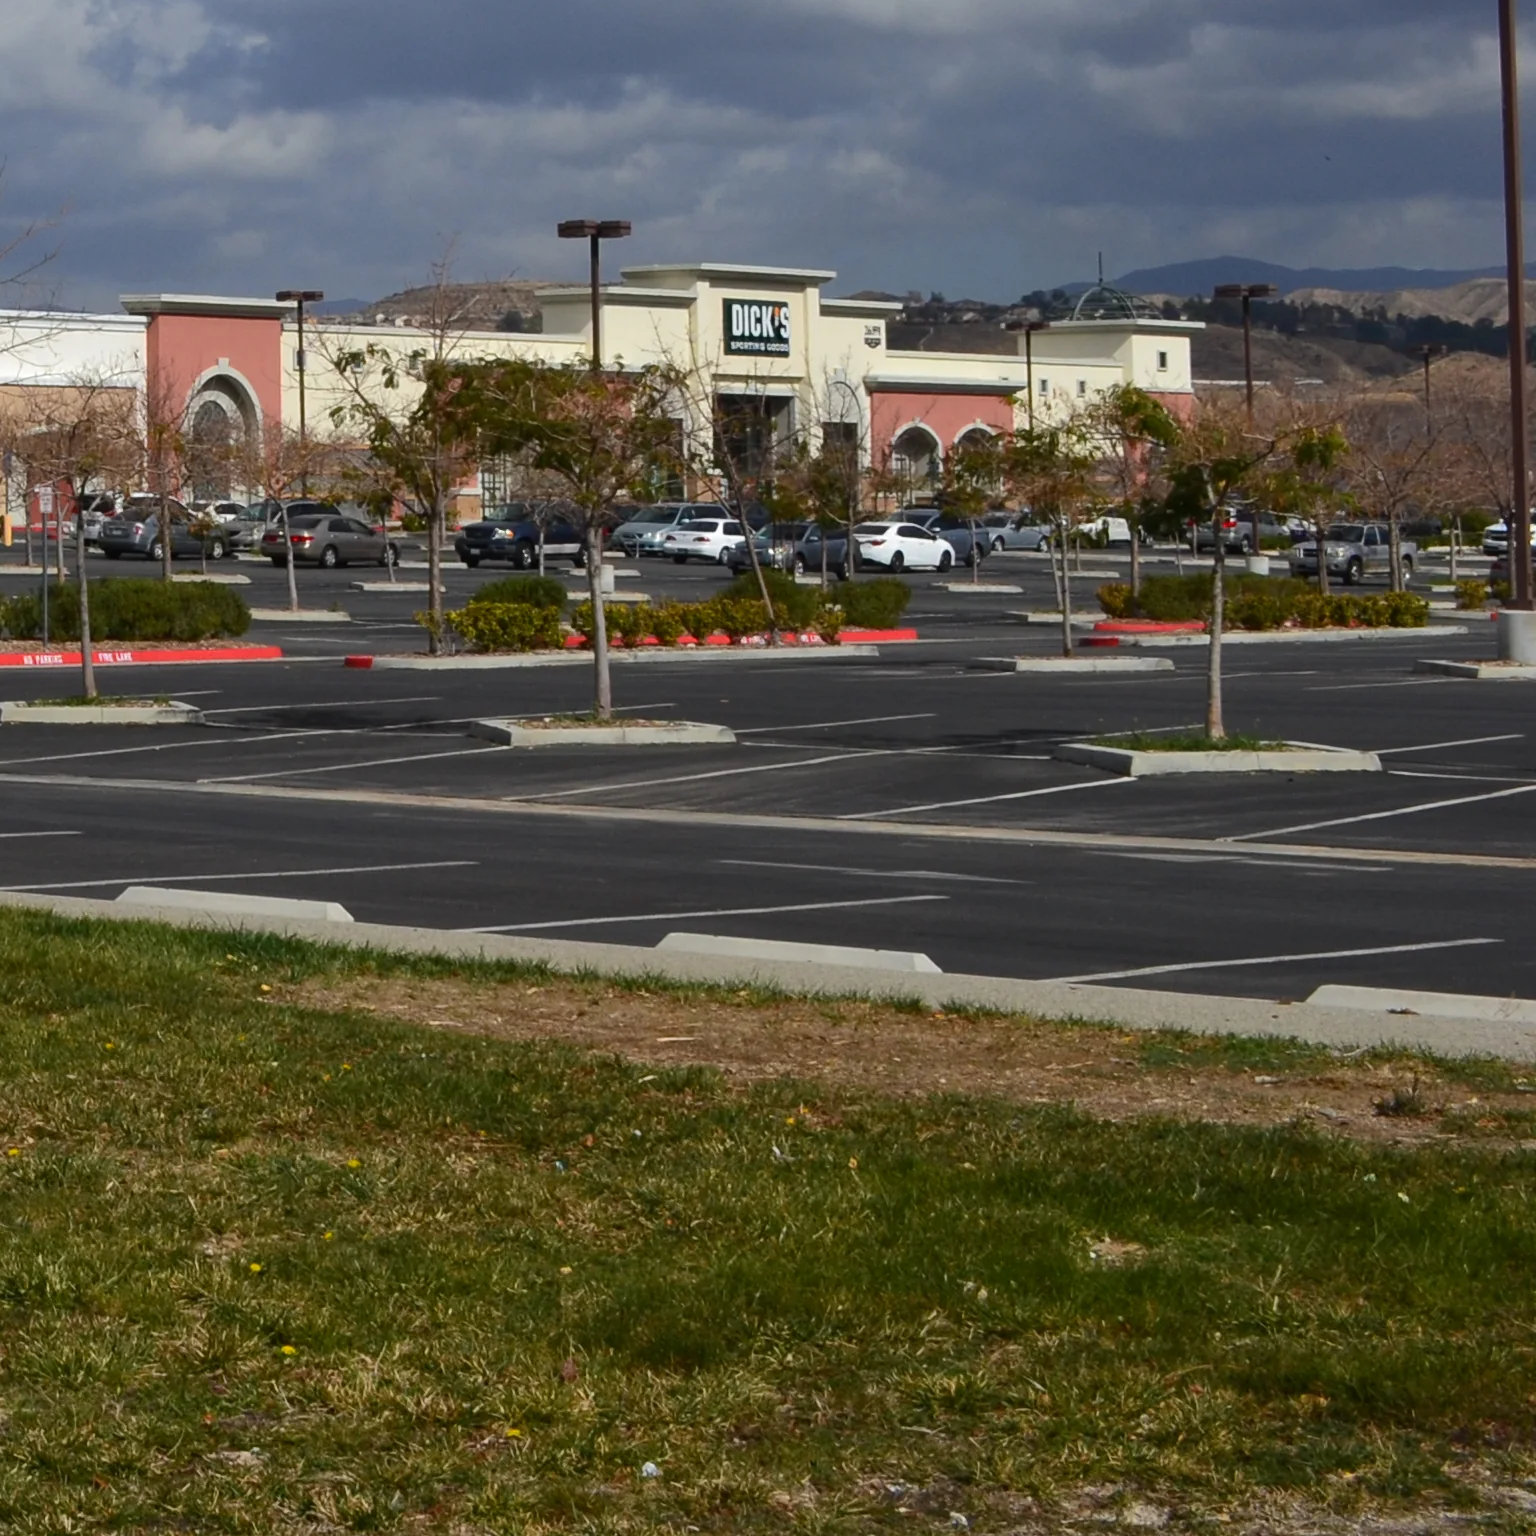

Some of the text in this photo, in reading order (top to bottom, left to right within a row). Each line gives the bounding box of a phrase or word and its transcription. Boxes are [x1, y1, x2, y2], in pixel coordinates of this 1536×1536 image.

[731, 304, 790, 339] DICK'S
[730, 341, 789, 352] SPORTING GOODS
